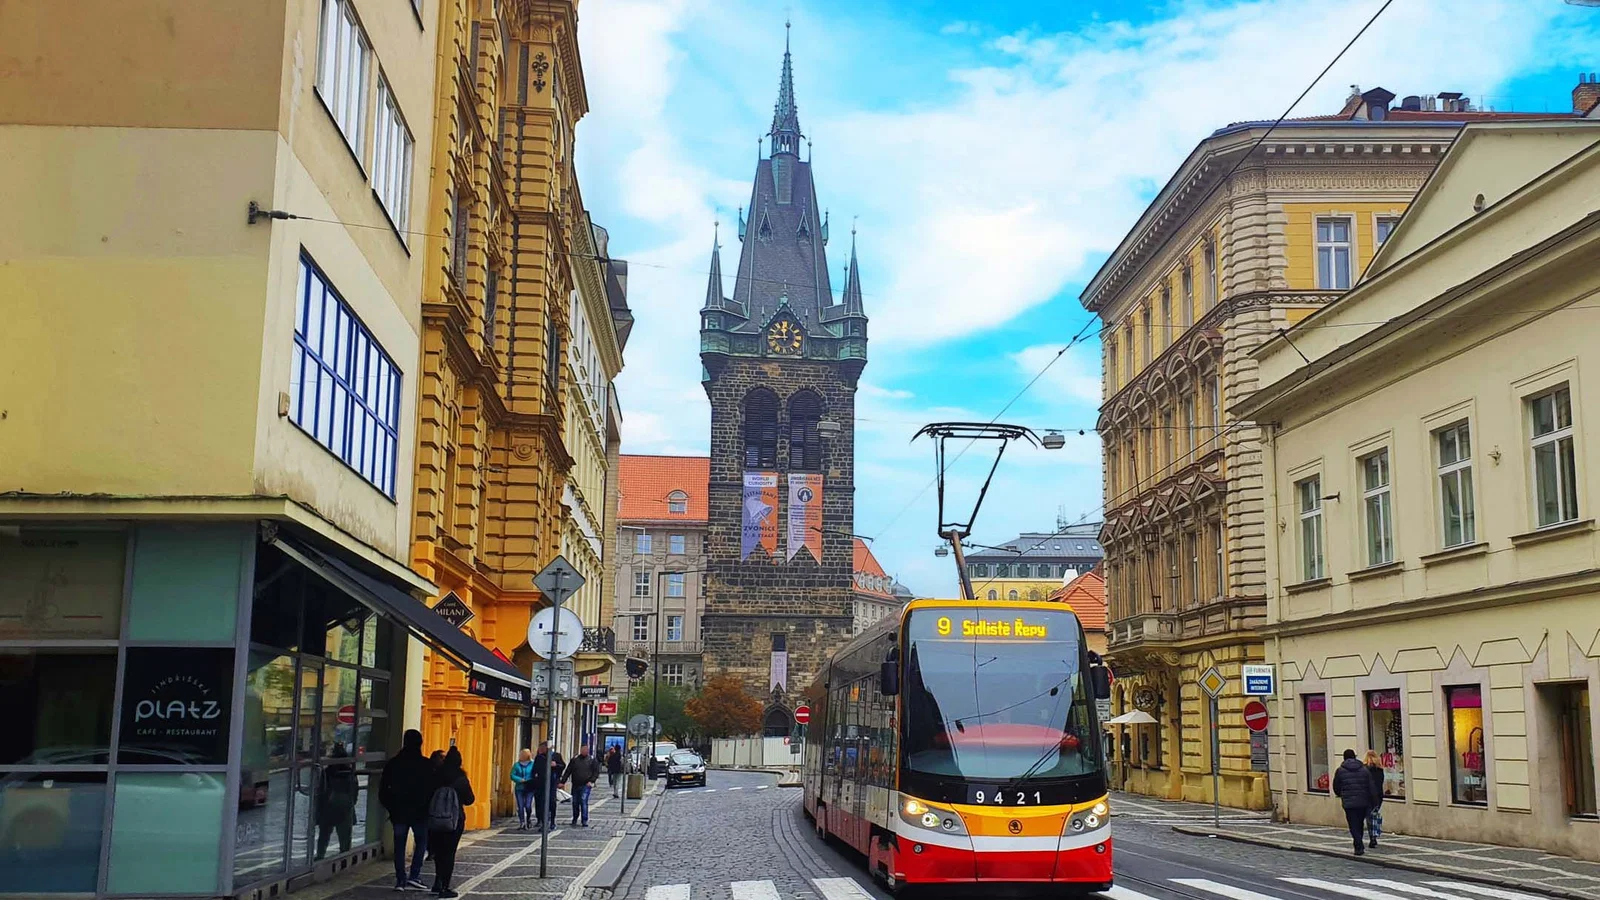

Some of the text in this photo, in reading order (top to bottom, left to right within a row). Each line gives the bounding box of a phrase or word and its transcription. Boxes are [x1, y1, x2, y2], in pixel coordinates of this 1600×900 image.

[435, 608, 465, 616] MILANI
[937, 616, 951, 636] 9
[1014, 617, 1047, 638] Řepy
